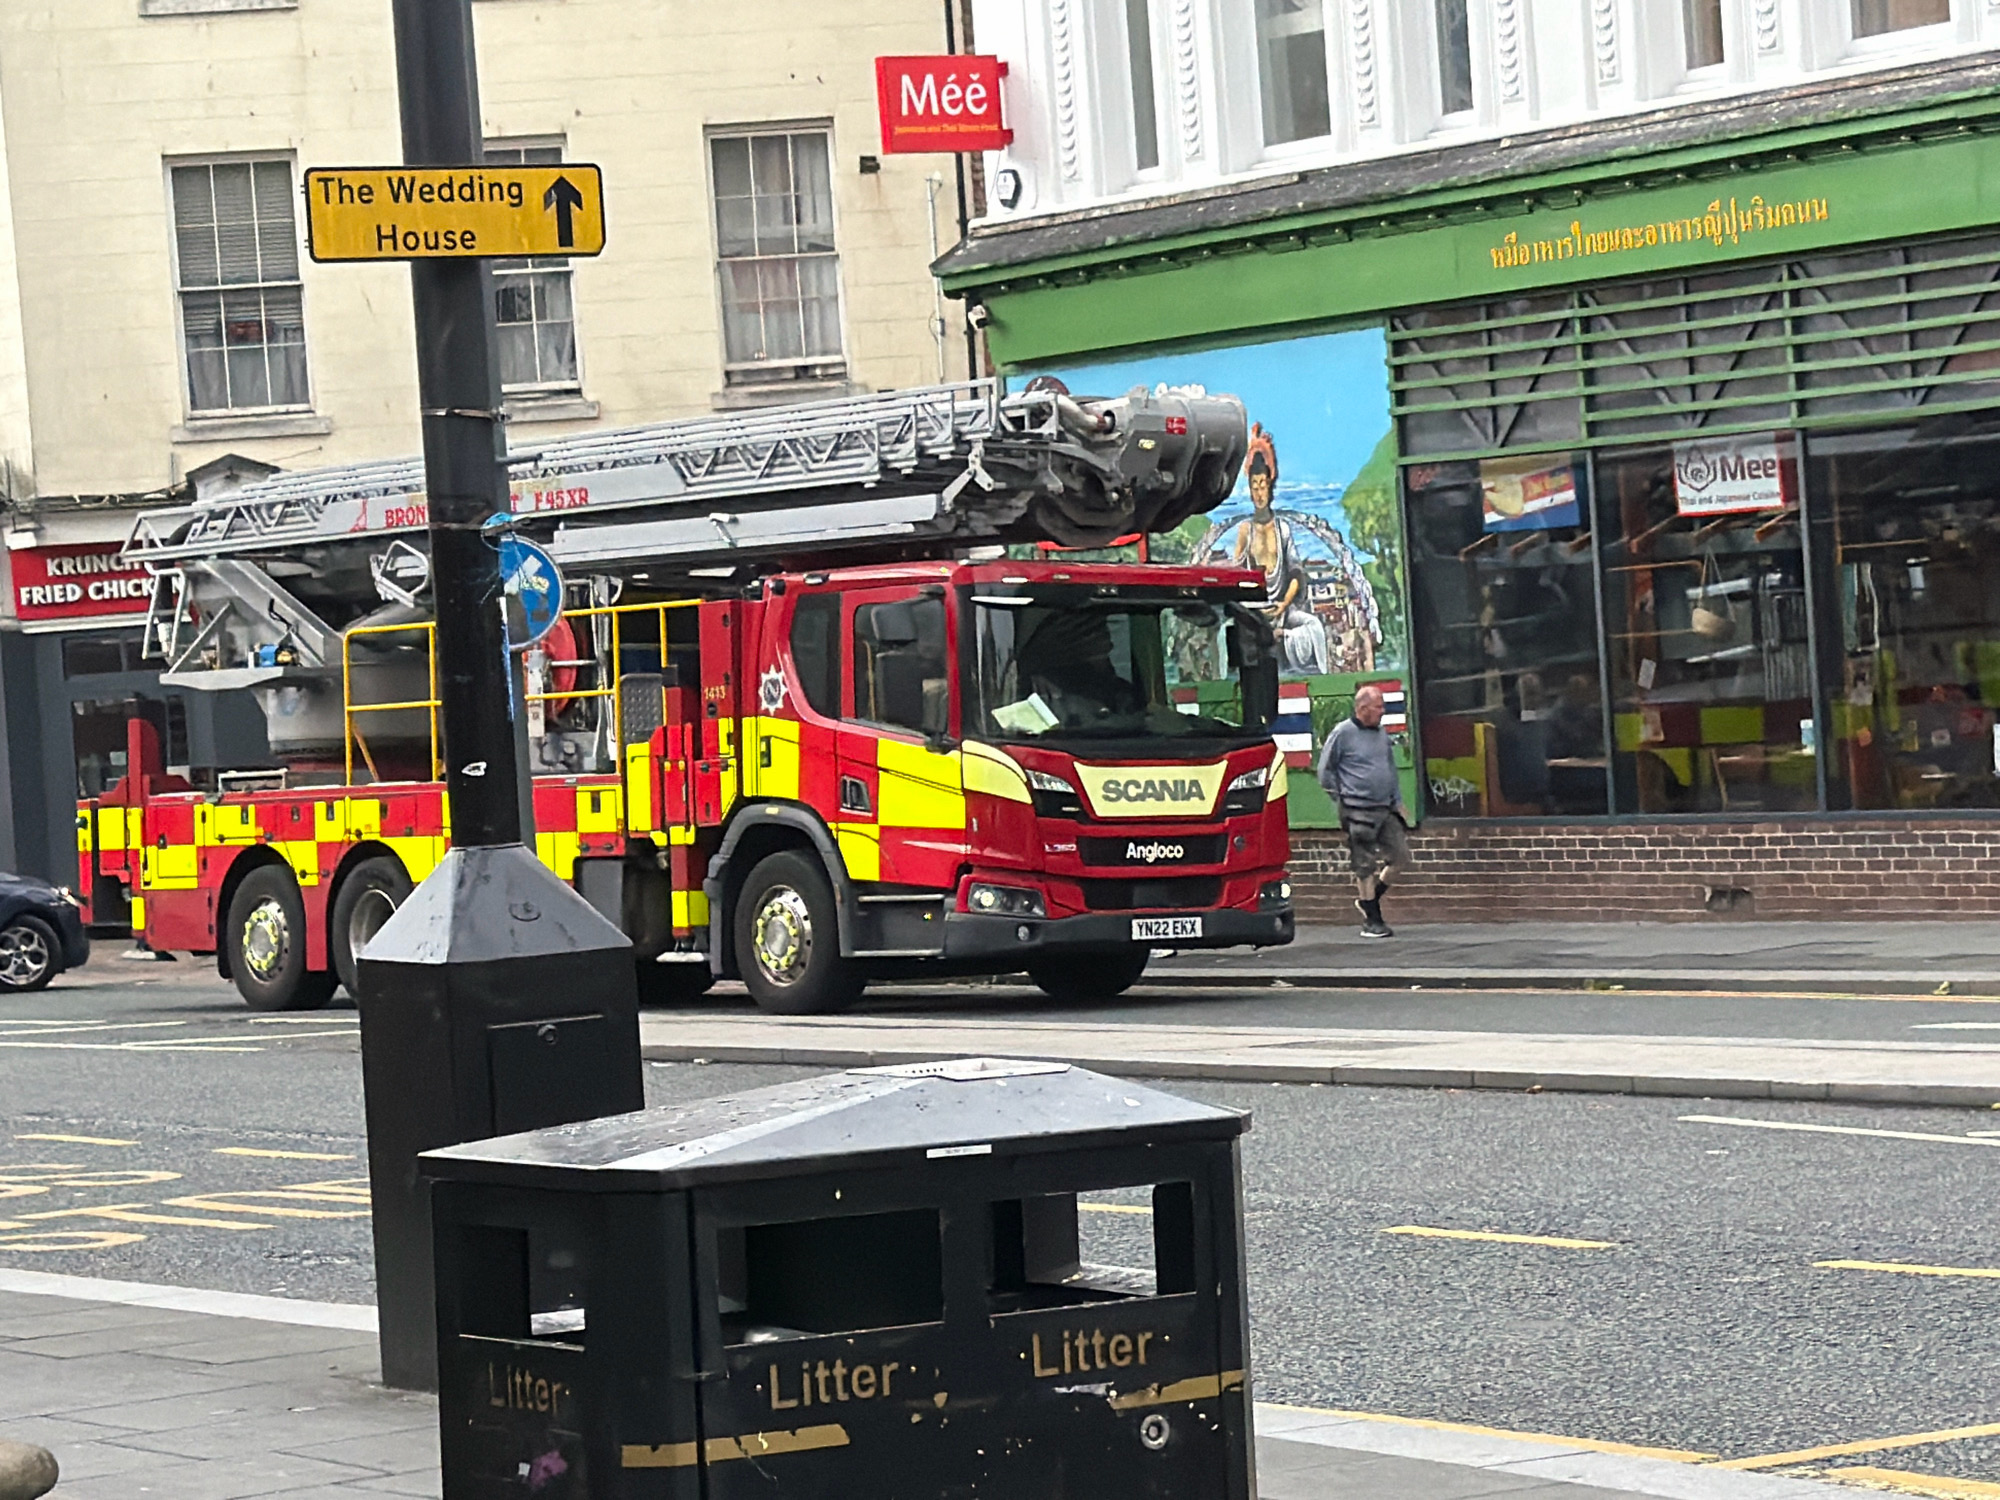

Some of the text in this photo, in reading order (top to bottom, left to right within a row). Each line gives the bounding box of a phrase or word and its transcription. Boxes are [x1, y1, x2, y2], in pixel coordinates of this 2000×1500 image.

[317, 175, 523, 208] The Wedding
[376, 224, 477, 252] House
[1719, 454, 1777, 481] Mee
[385, 505, 427, 528] BRON
[20, 577, 184, 606] FRIED CHICKN
[1102, 779, 1205, 802] SCANIA
[1126, 841, 1184, 863] Angloco
[1137, 920, 1197, 936] YN22 EKX
[1032, 1328, 1153, 1377] Litter
[488, 1362, 562, 1415] Litter
[769, 1359, 899, 1410] Litter
